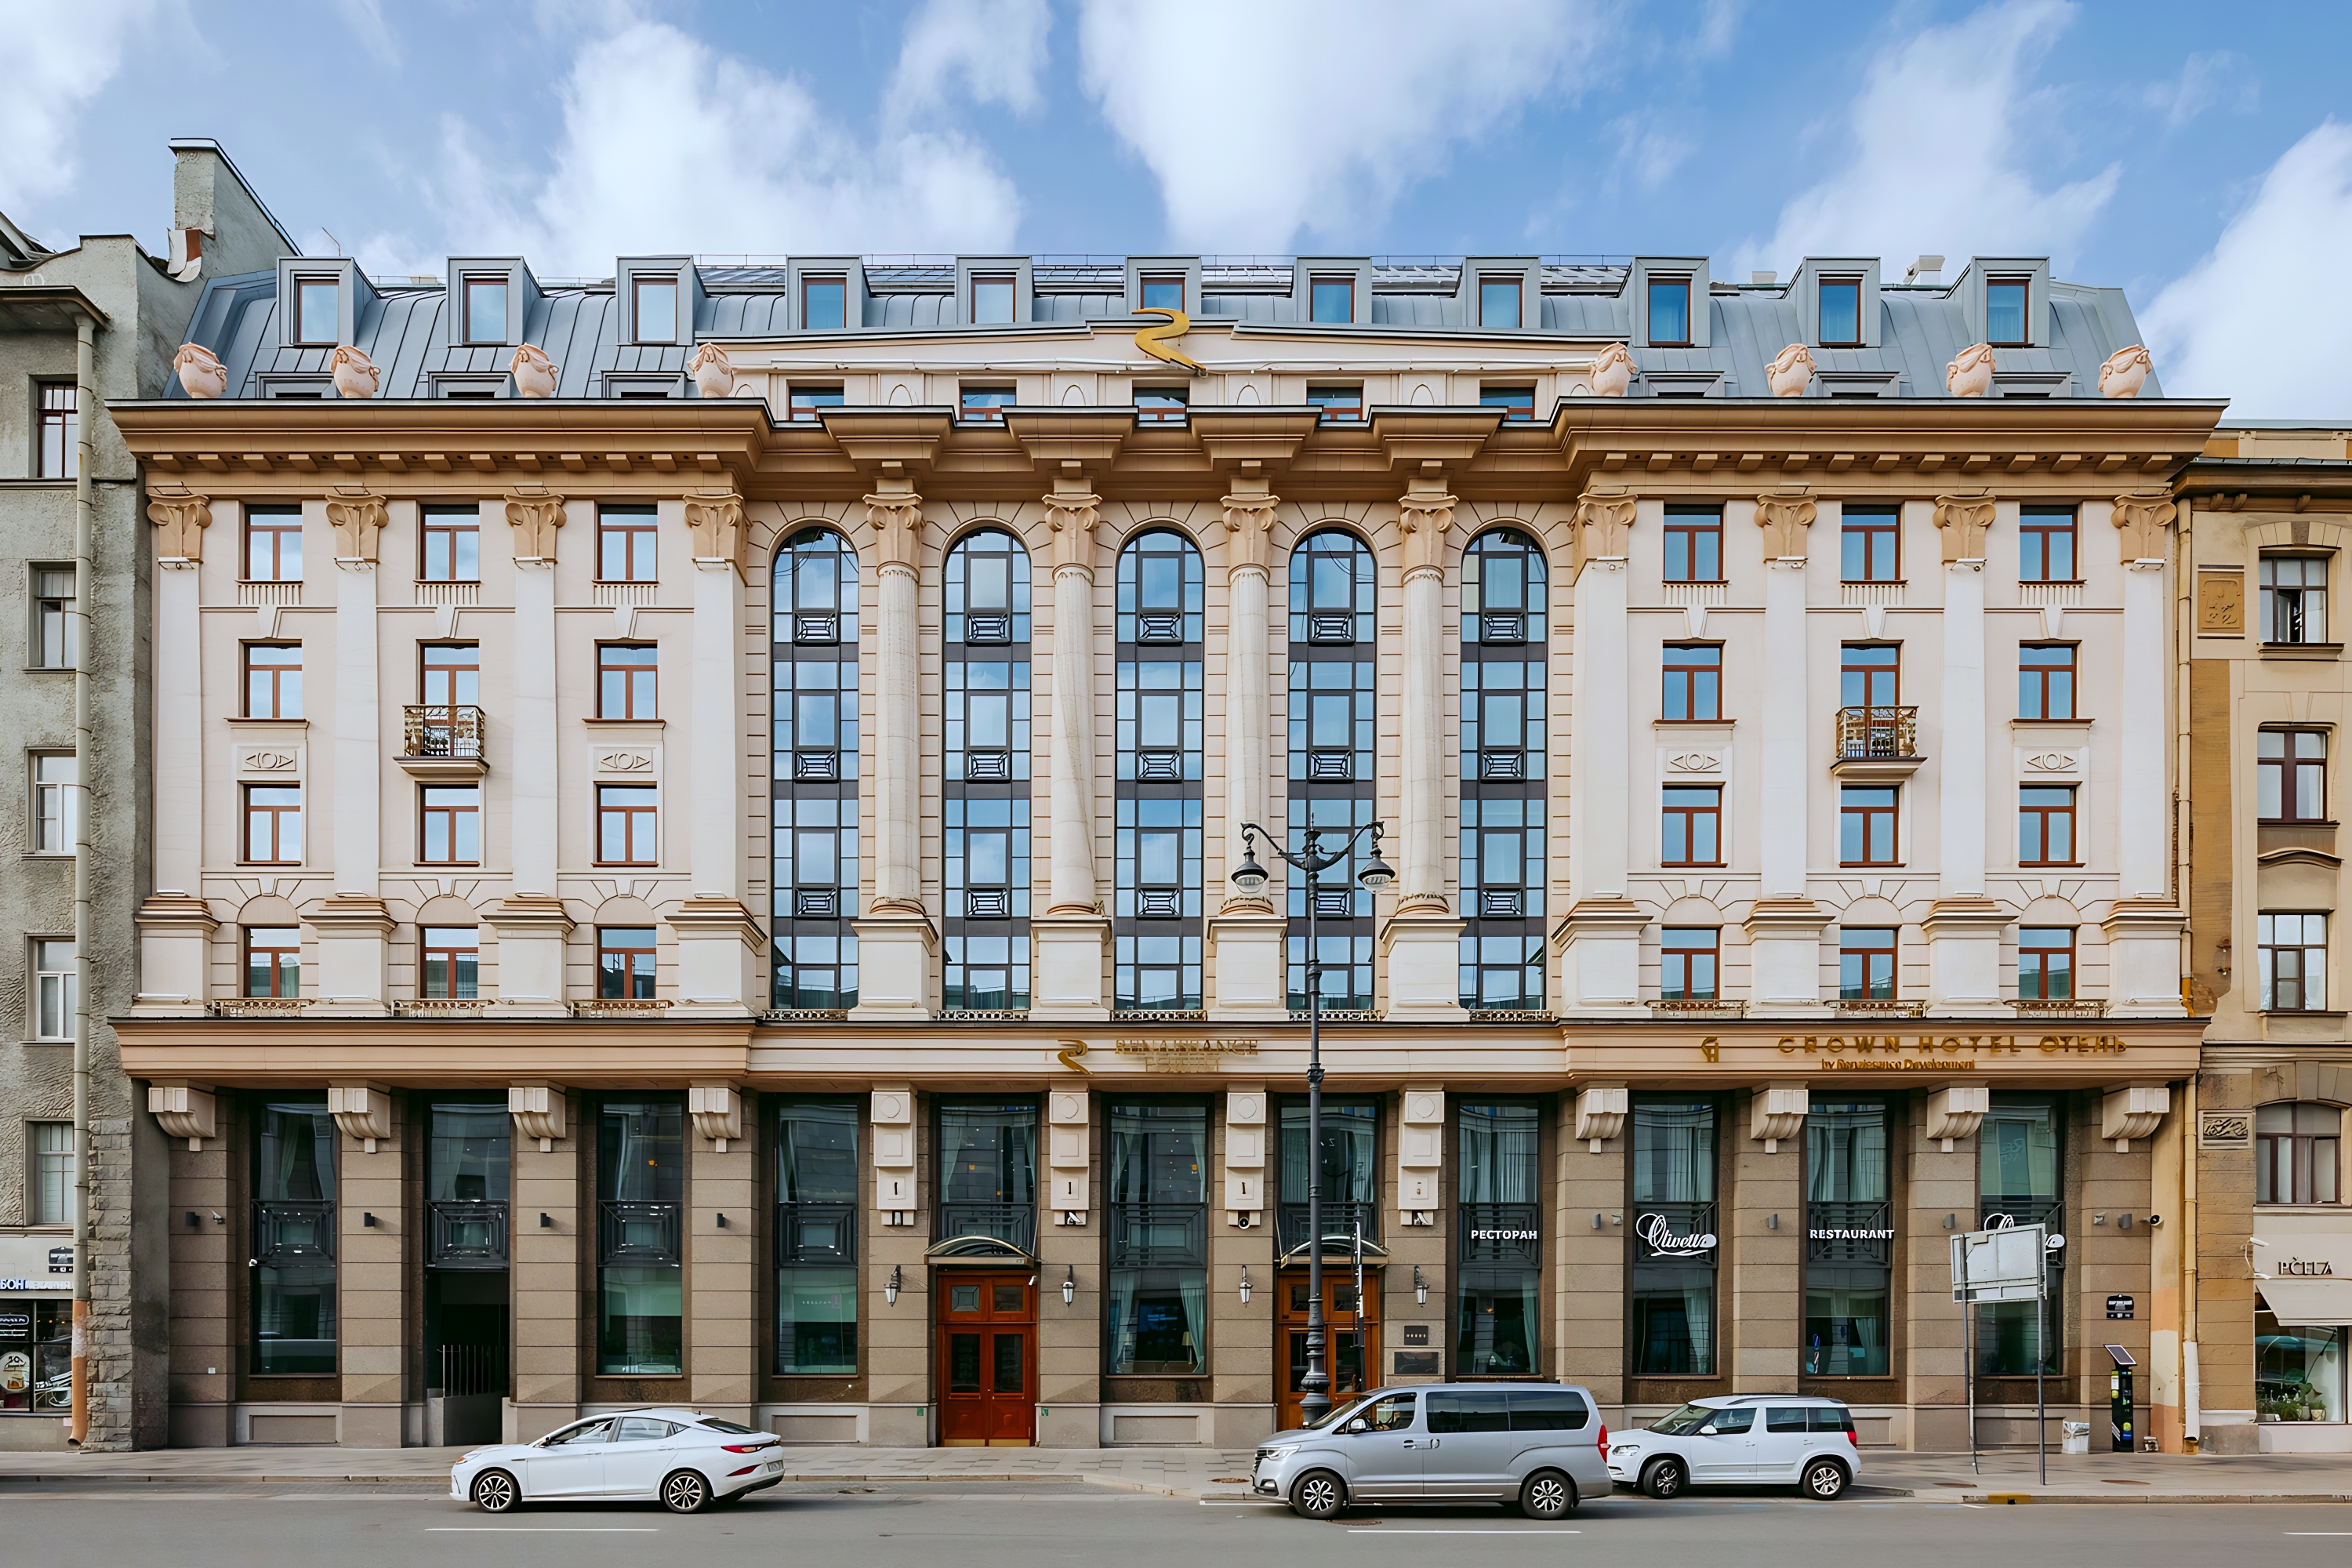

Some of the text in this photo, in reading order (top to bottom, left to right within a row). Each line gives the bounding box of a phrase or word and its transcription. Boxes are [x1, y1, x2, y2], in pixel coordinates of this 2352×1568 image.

[1778, 1036, 2021, 1053] CROWN HOTEL
[1471, 1230, 1537, 1240] РЕСТОРАН
[1809, 1229, 1895, 1240] RESTAURANT
